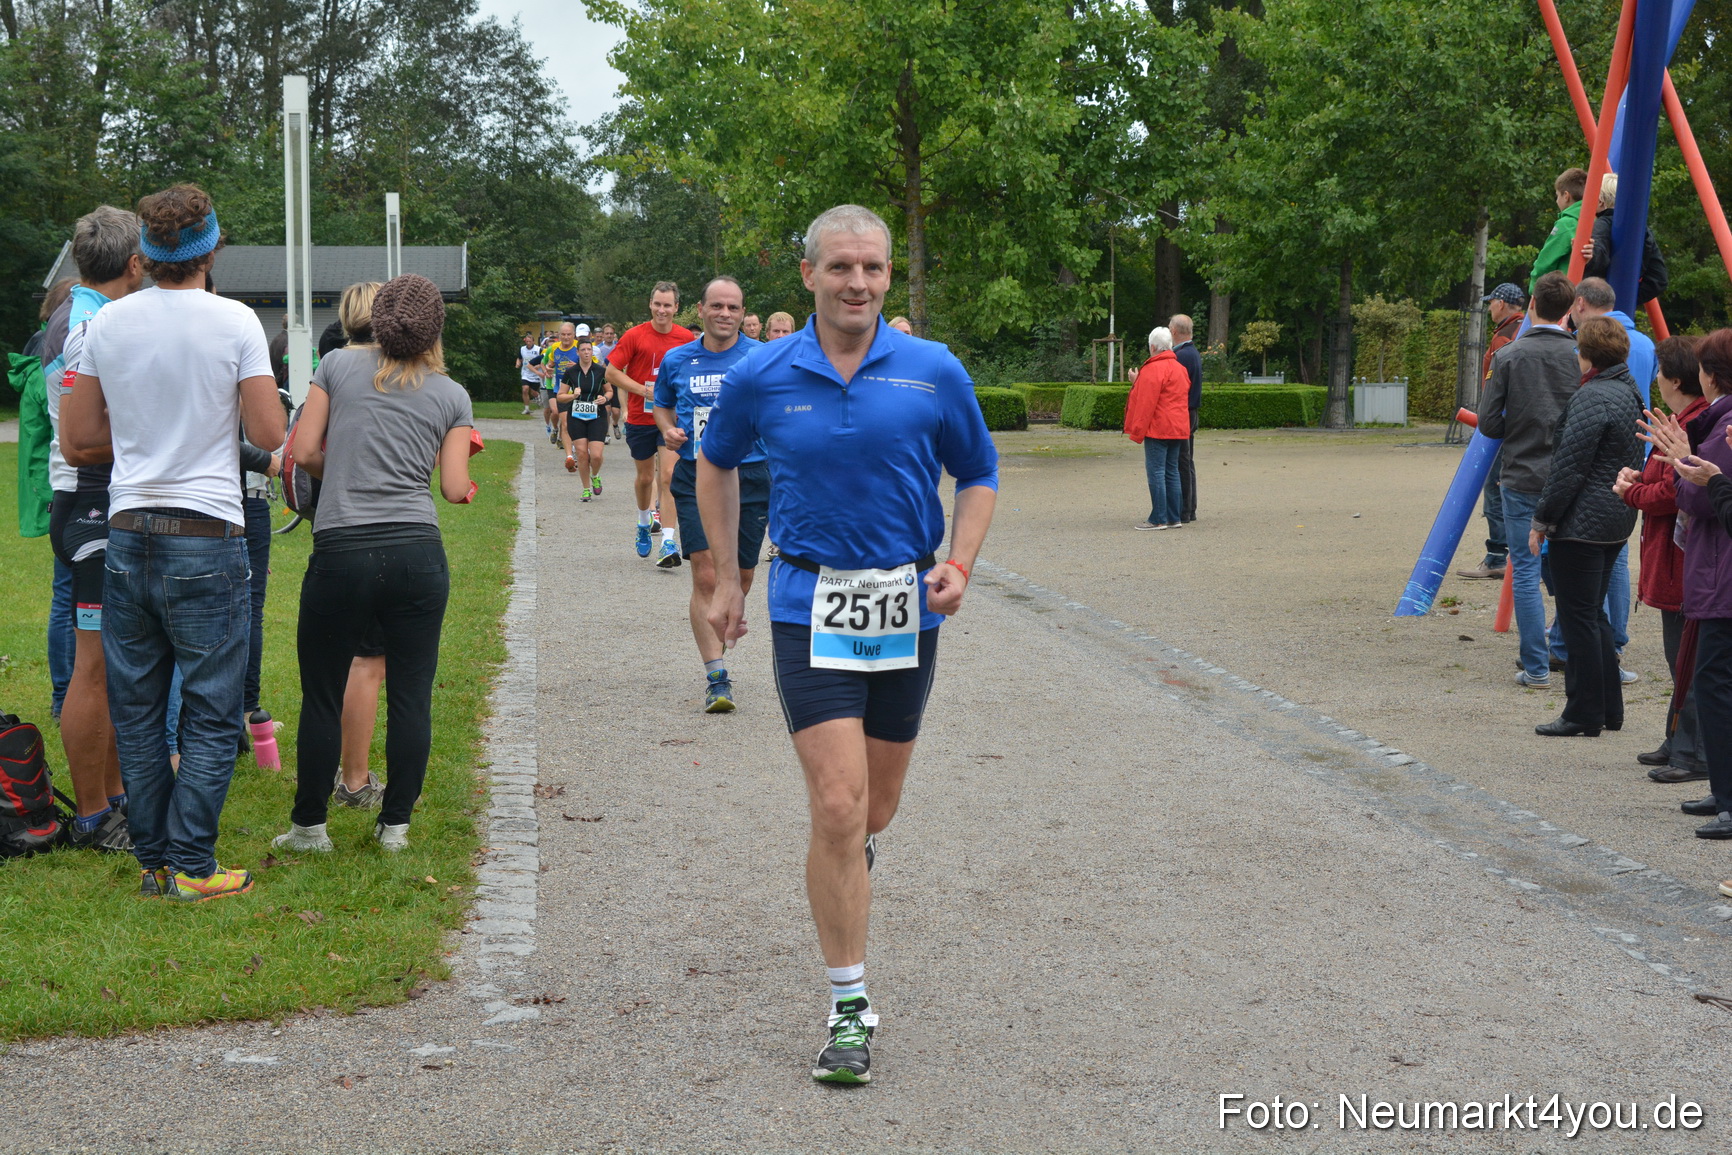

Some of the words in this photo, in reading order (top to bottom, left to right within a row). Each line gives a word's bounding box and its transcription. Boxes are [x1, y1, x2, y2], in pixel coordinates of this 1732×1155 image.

[575, 404, 595, 413] 2380
[820, 576, 855, 588] PARTL
[857, 577, 903, 589] Neumarkt
[824, 592, 909, 631] 2513
[853, 641, 881, 656] Uwe
